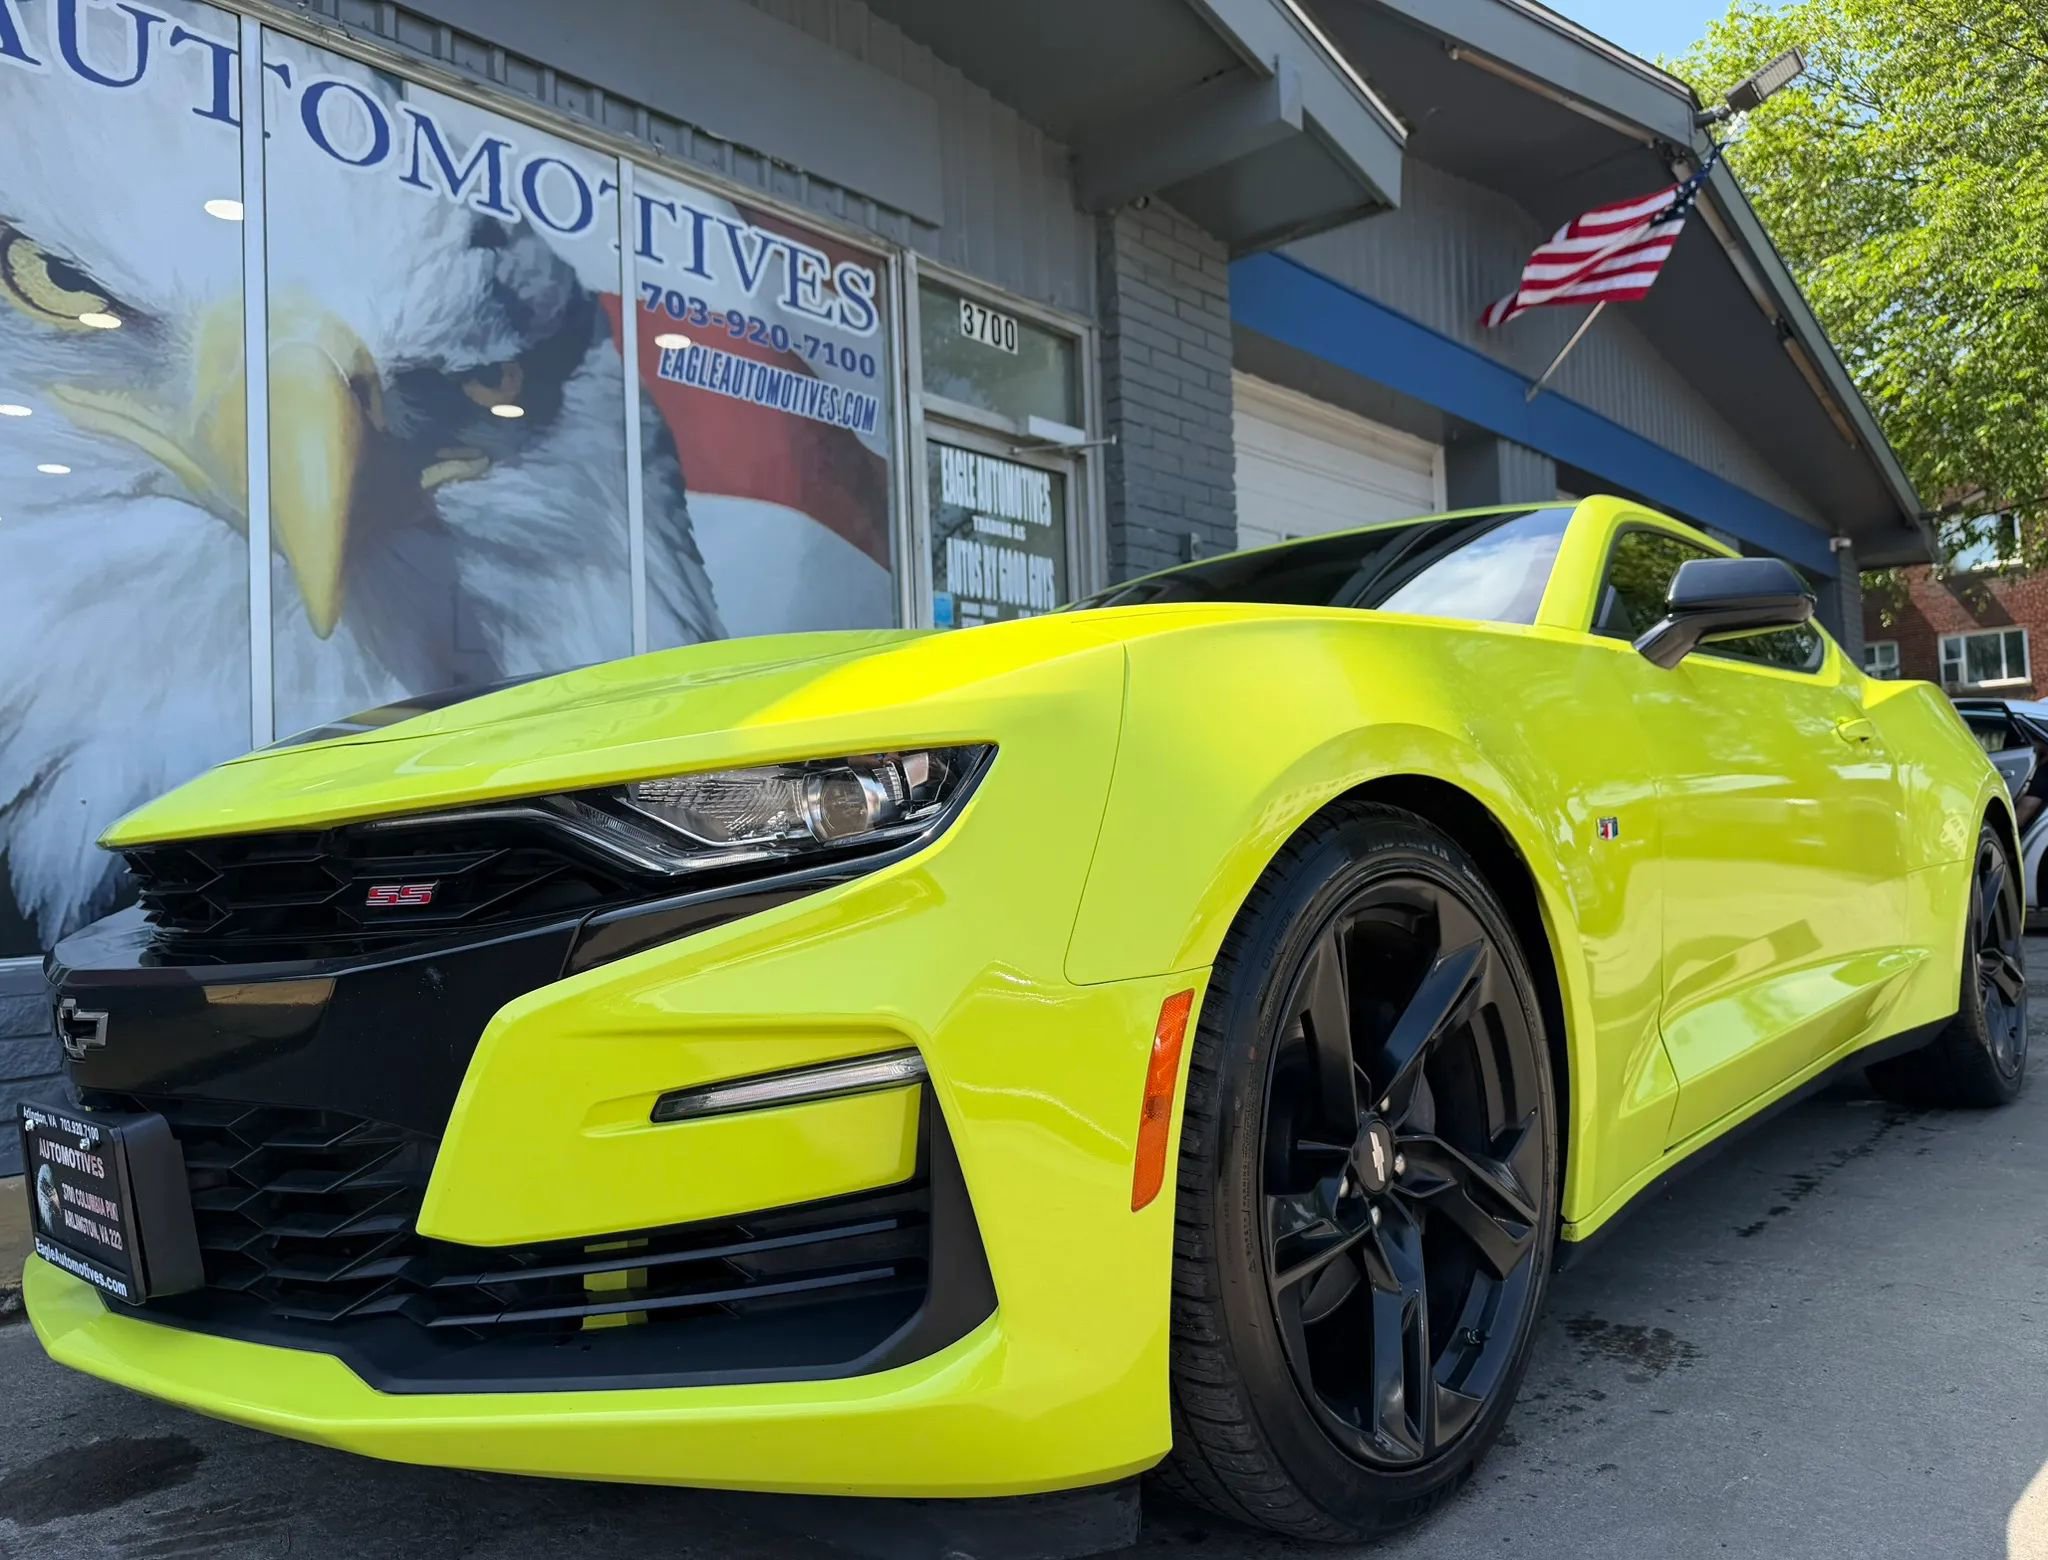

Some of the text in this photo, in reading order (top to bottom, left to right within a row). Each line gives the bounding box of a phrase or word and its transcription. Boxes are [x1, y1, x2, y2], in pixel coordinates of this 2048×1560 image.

[641, 281, 876, 379] 703-920-7100
[964, 303, 1015, 351] 3700
[660, 346, 879, 433] EAGLEAUTOMOTIVES.COM
[941, 446, 1052, 528] EAGLE AUTOMOTIVES
[366, 880, 440, 906] SS
[39, 1137, 105, 1180] AUTOMOTIVES
[35, 1236, 128, 1297] EagleAutomotives.com
